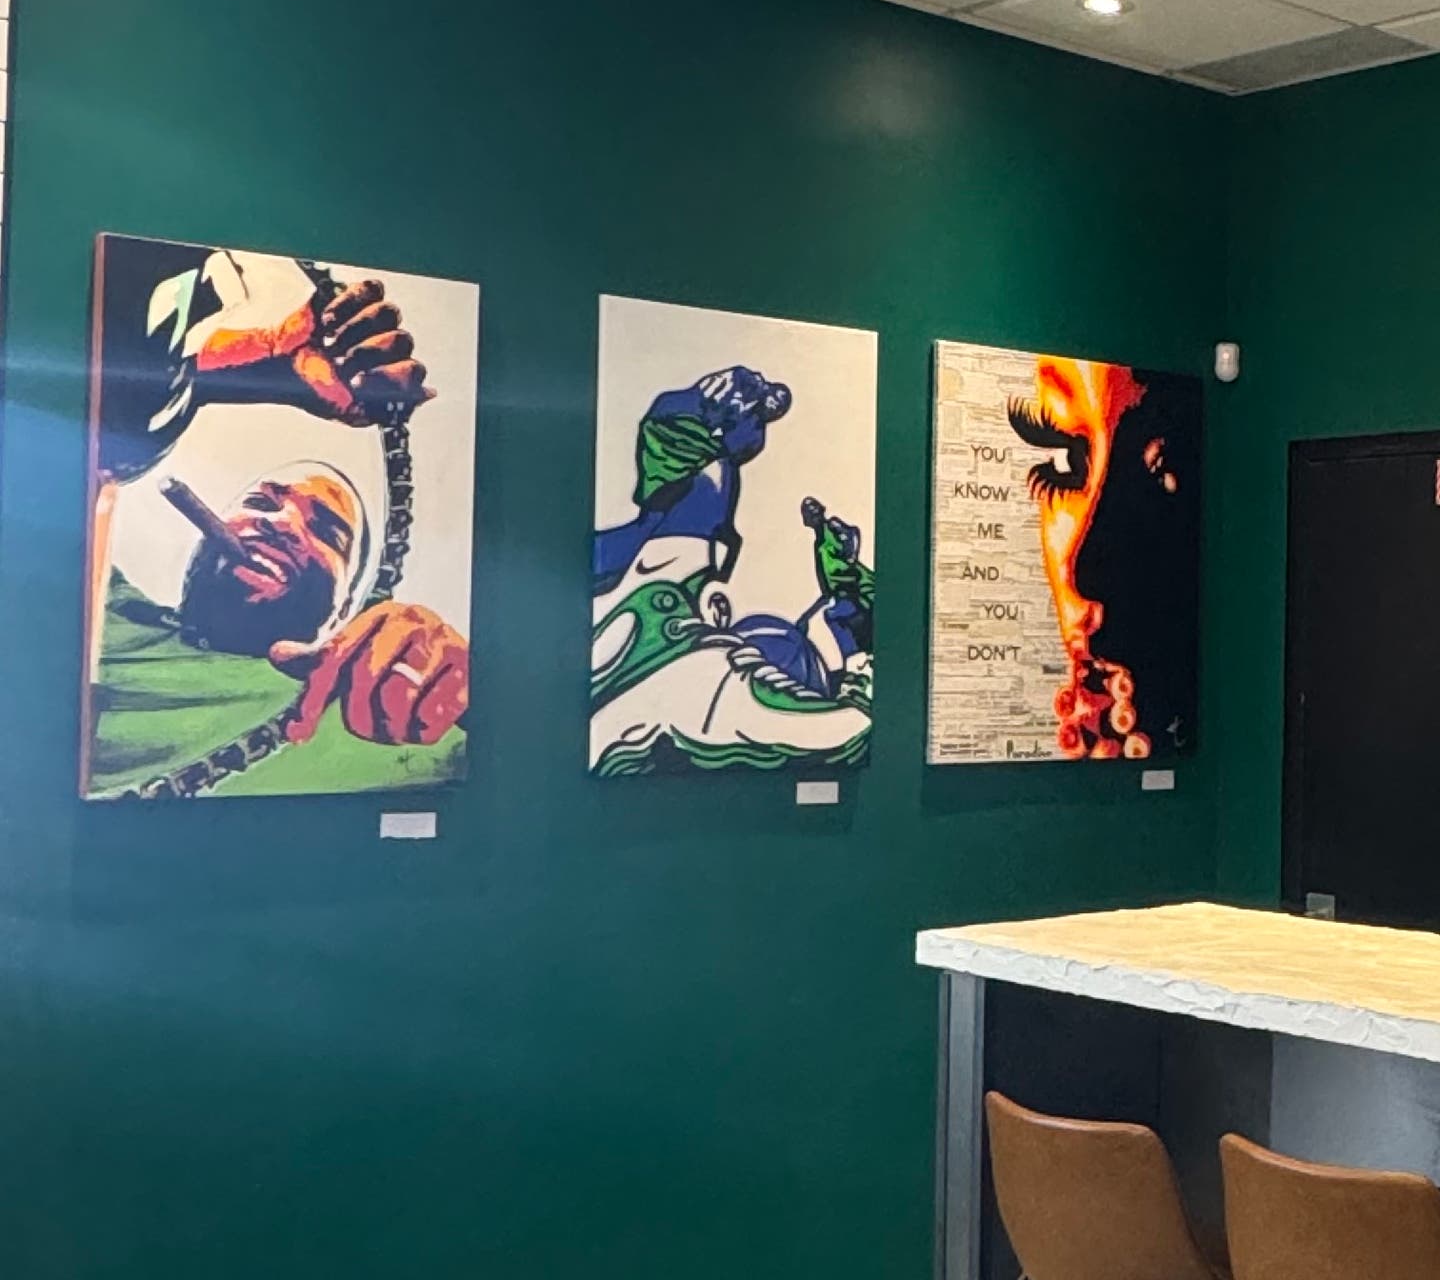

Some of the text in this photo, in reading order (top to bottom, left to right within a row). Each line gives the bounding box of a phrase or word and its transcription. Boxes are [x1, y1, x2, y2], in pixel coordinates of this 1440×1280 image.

[970, 444, 1006, 464] YOU
[954, 482, 1010, 502] KNOW
[977, 522, 1006, 540] ME
[961, 565, 1000, 581] AND
[983, 603, 1018, 620] YOU
[967, 645, 1021, 661] DON'T
